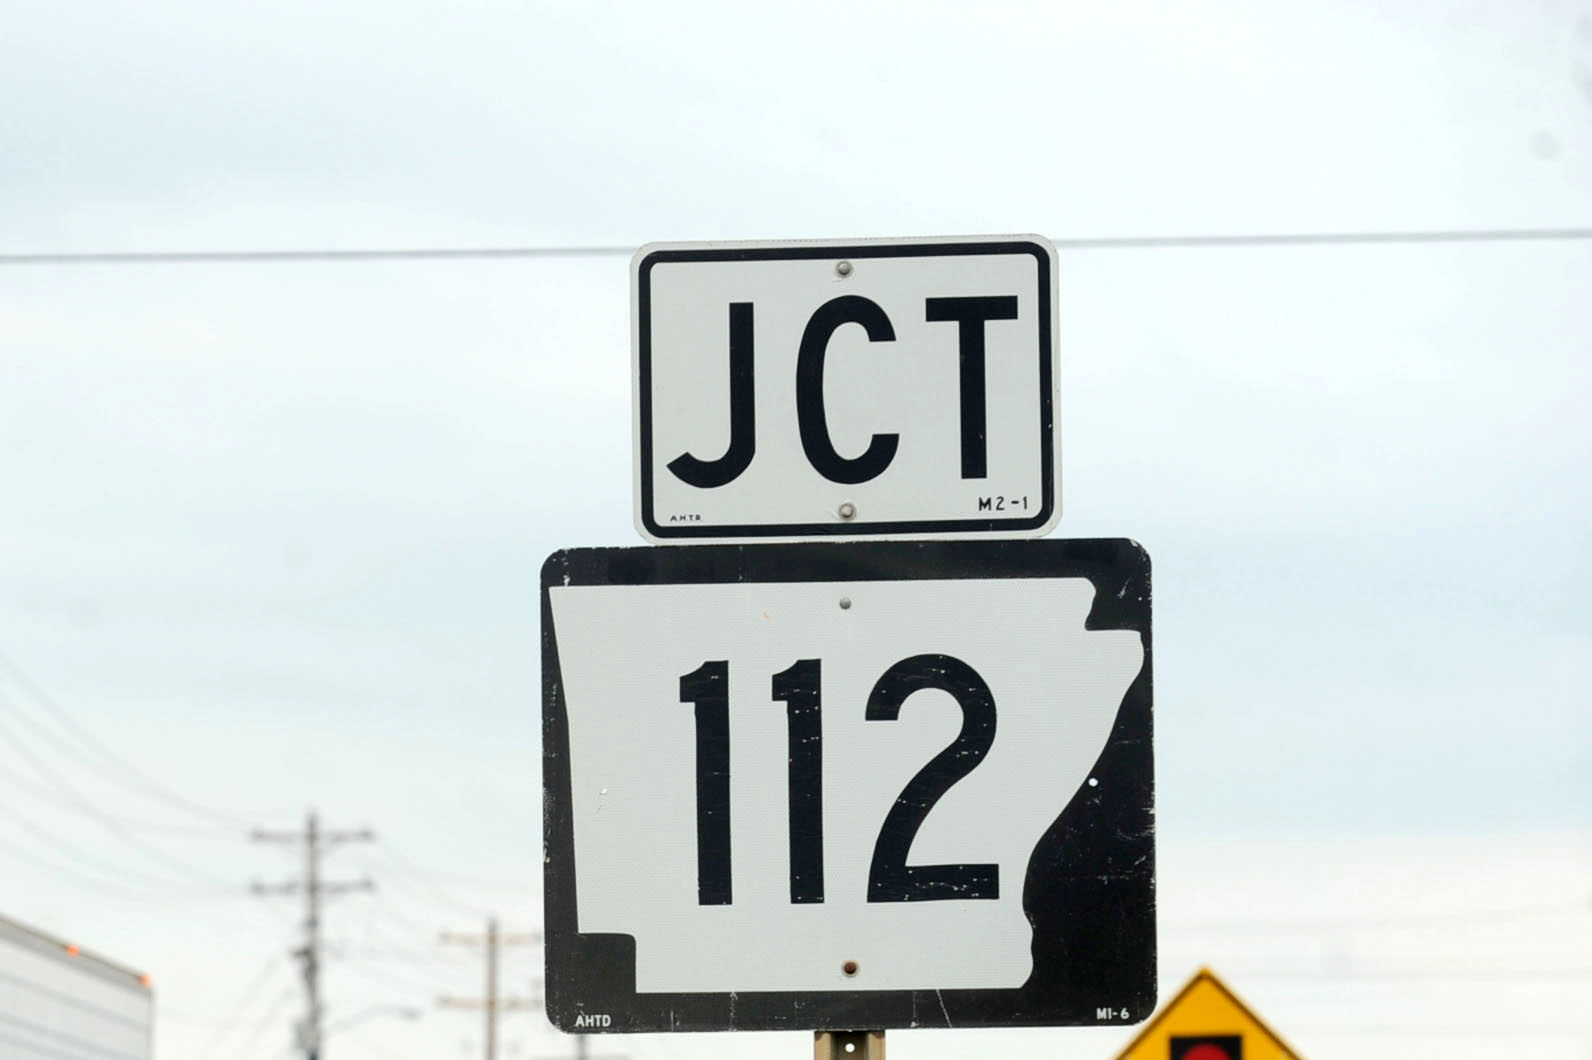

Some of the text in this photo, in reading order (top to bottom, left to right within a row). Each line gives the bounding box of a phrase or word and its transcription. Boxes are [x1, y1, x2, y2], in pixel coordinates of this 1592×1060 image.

[666, 295, 1019, 489] JCT
[978, 495, 1028, 511] M2-1
[679, 653, 1000, 906] 112
[575, 1014, 612, 1027] AHTD
